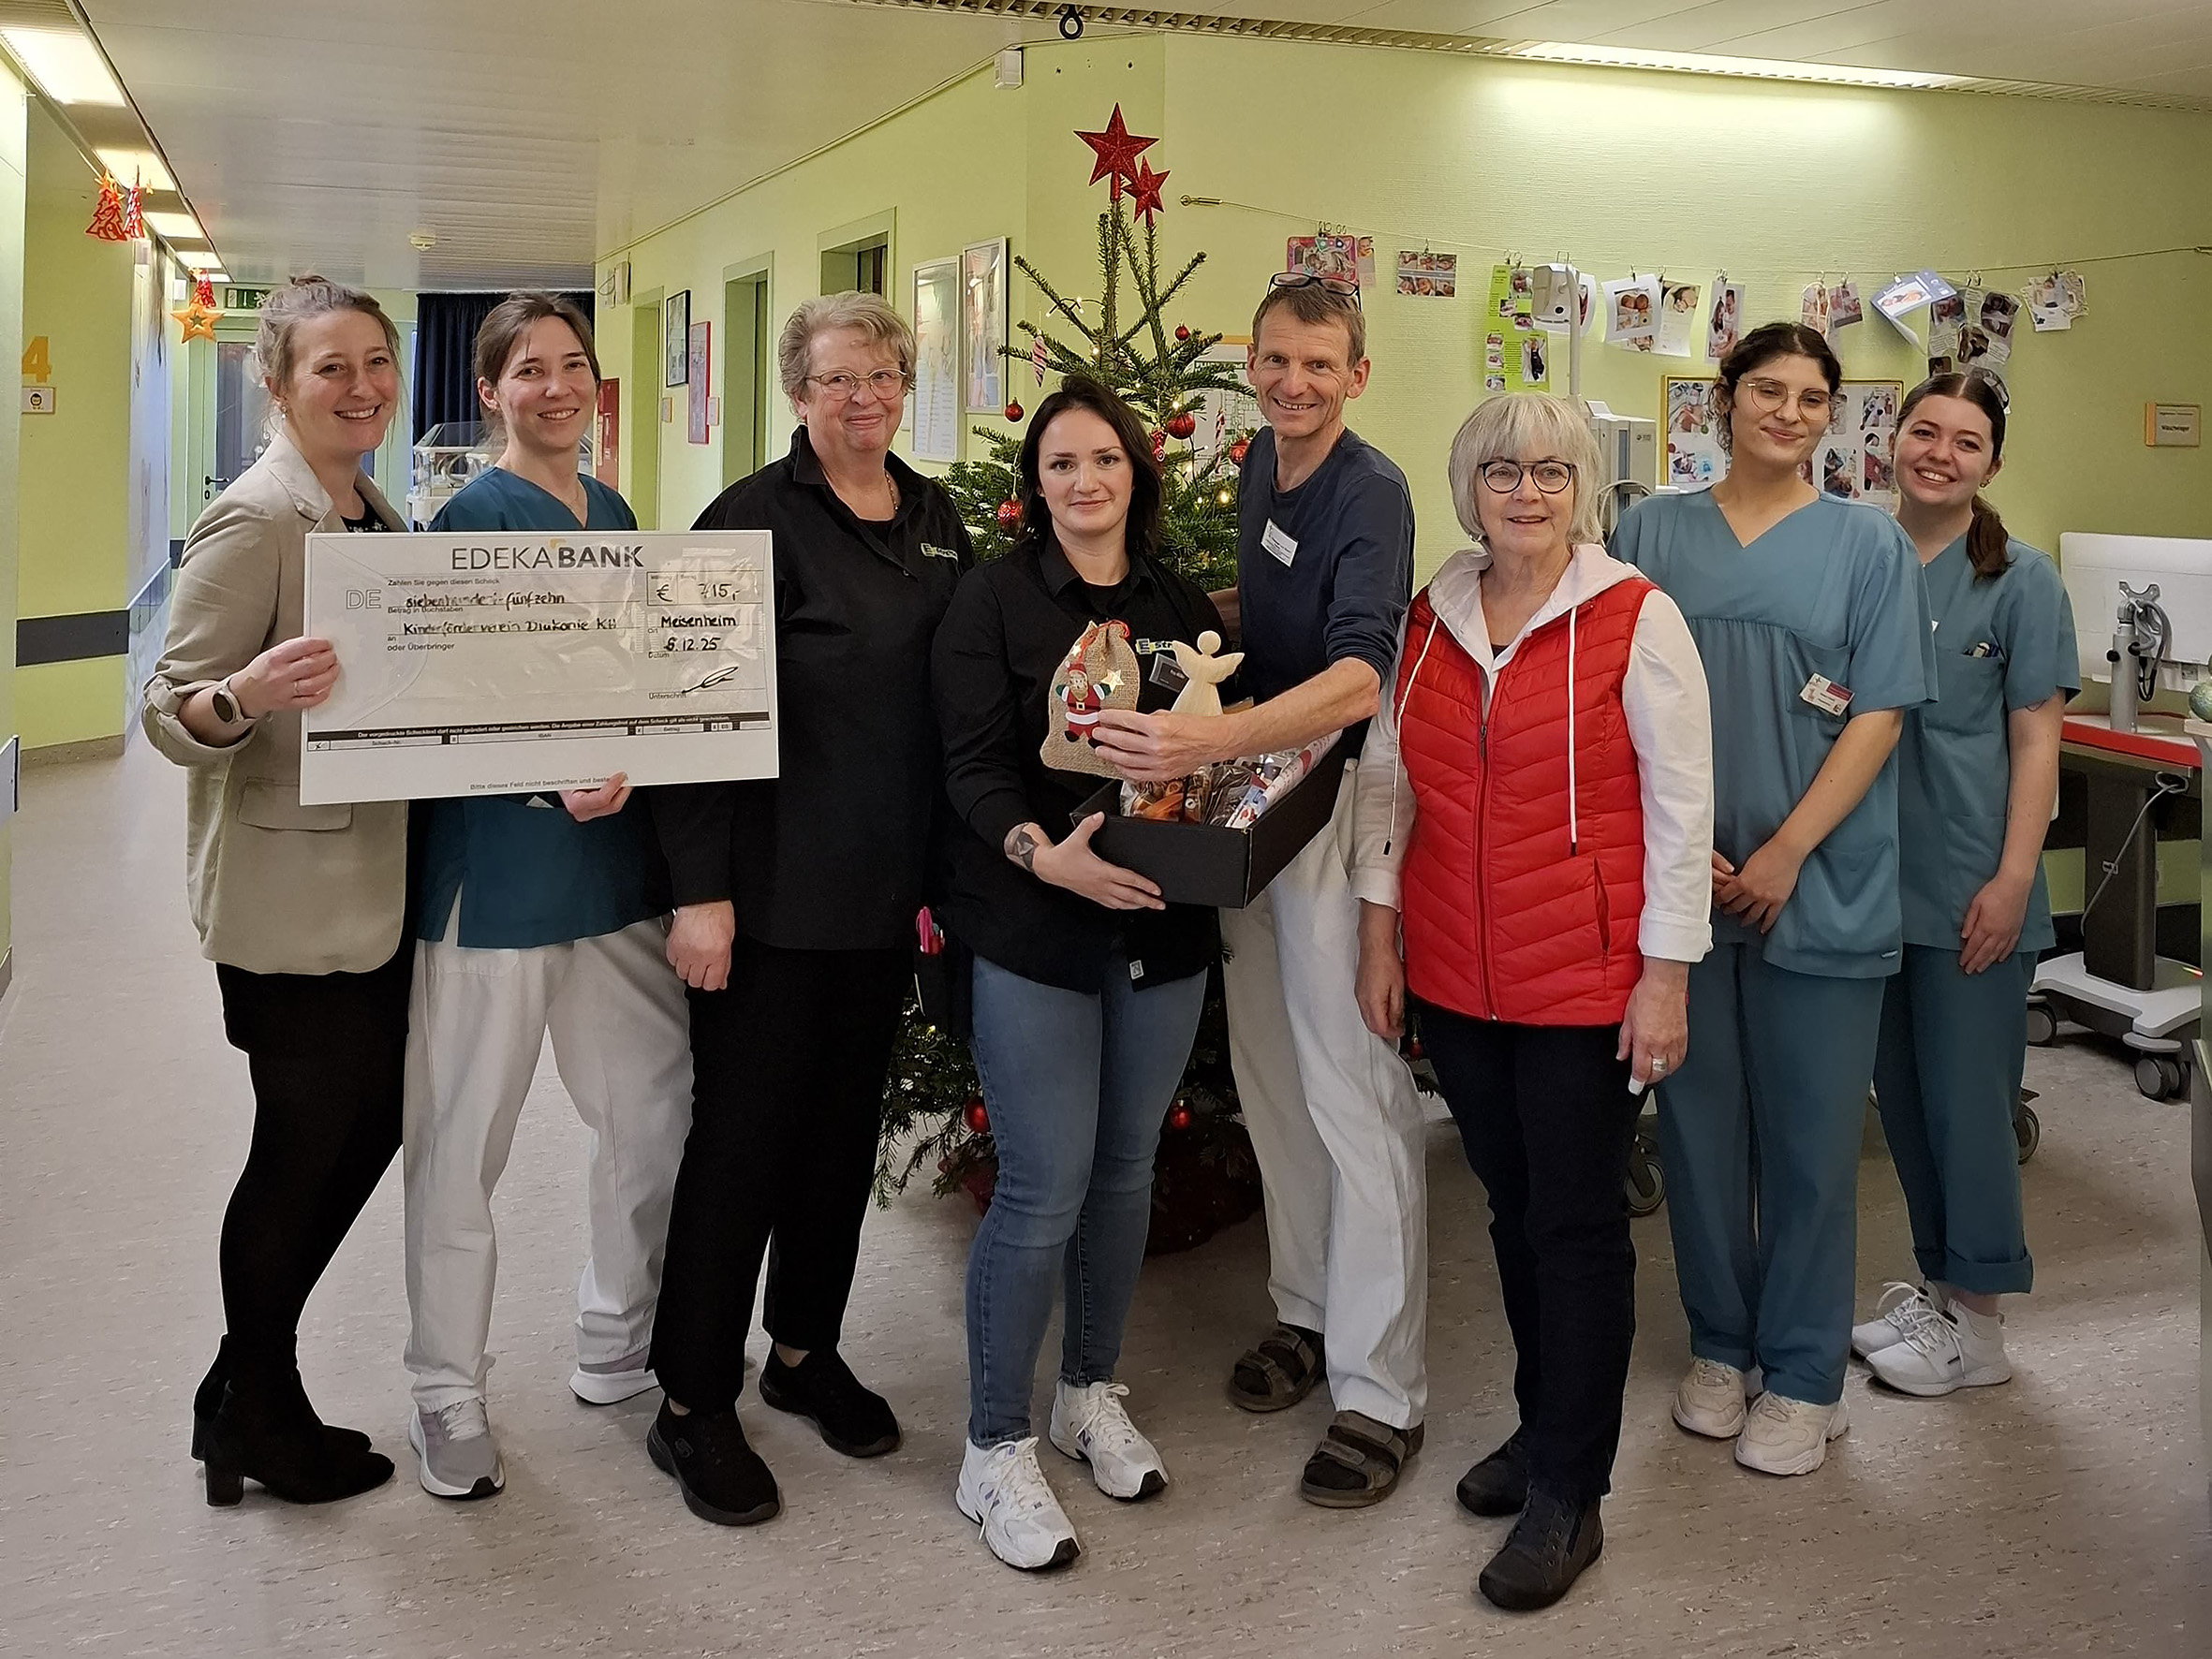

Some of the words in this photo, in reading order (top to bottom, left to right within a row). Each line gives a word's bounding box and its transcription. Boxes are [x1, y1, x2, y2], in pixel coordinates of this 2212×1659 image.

[22, 336, 51, 383] 4
[346, 589, 382, 609] DE
[388, 607, 412, 615] Betrag
[421, 605, 464, 613] Buchstaben
[660, 614, 737, 628] Meisenheim
[407, 642, 455, 652] Überbringer
[648, 692, 686, 700] Unterschrift
[542, 778, 578, 786] beschriften
